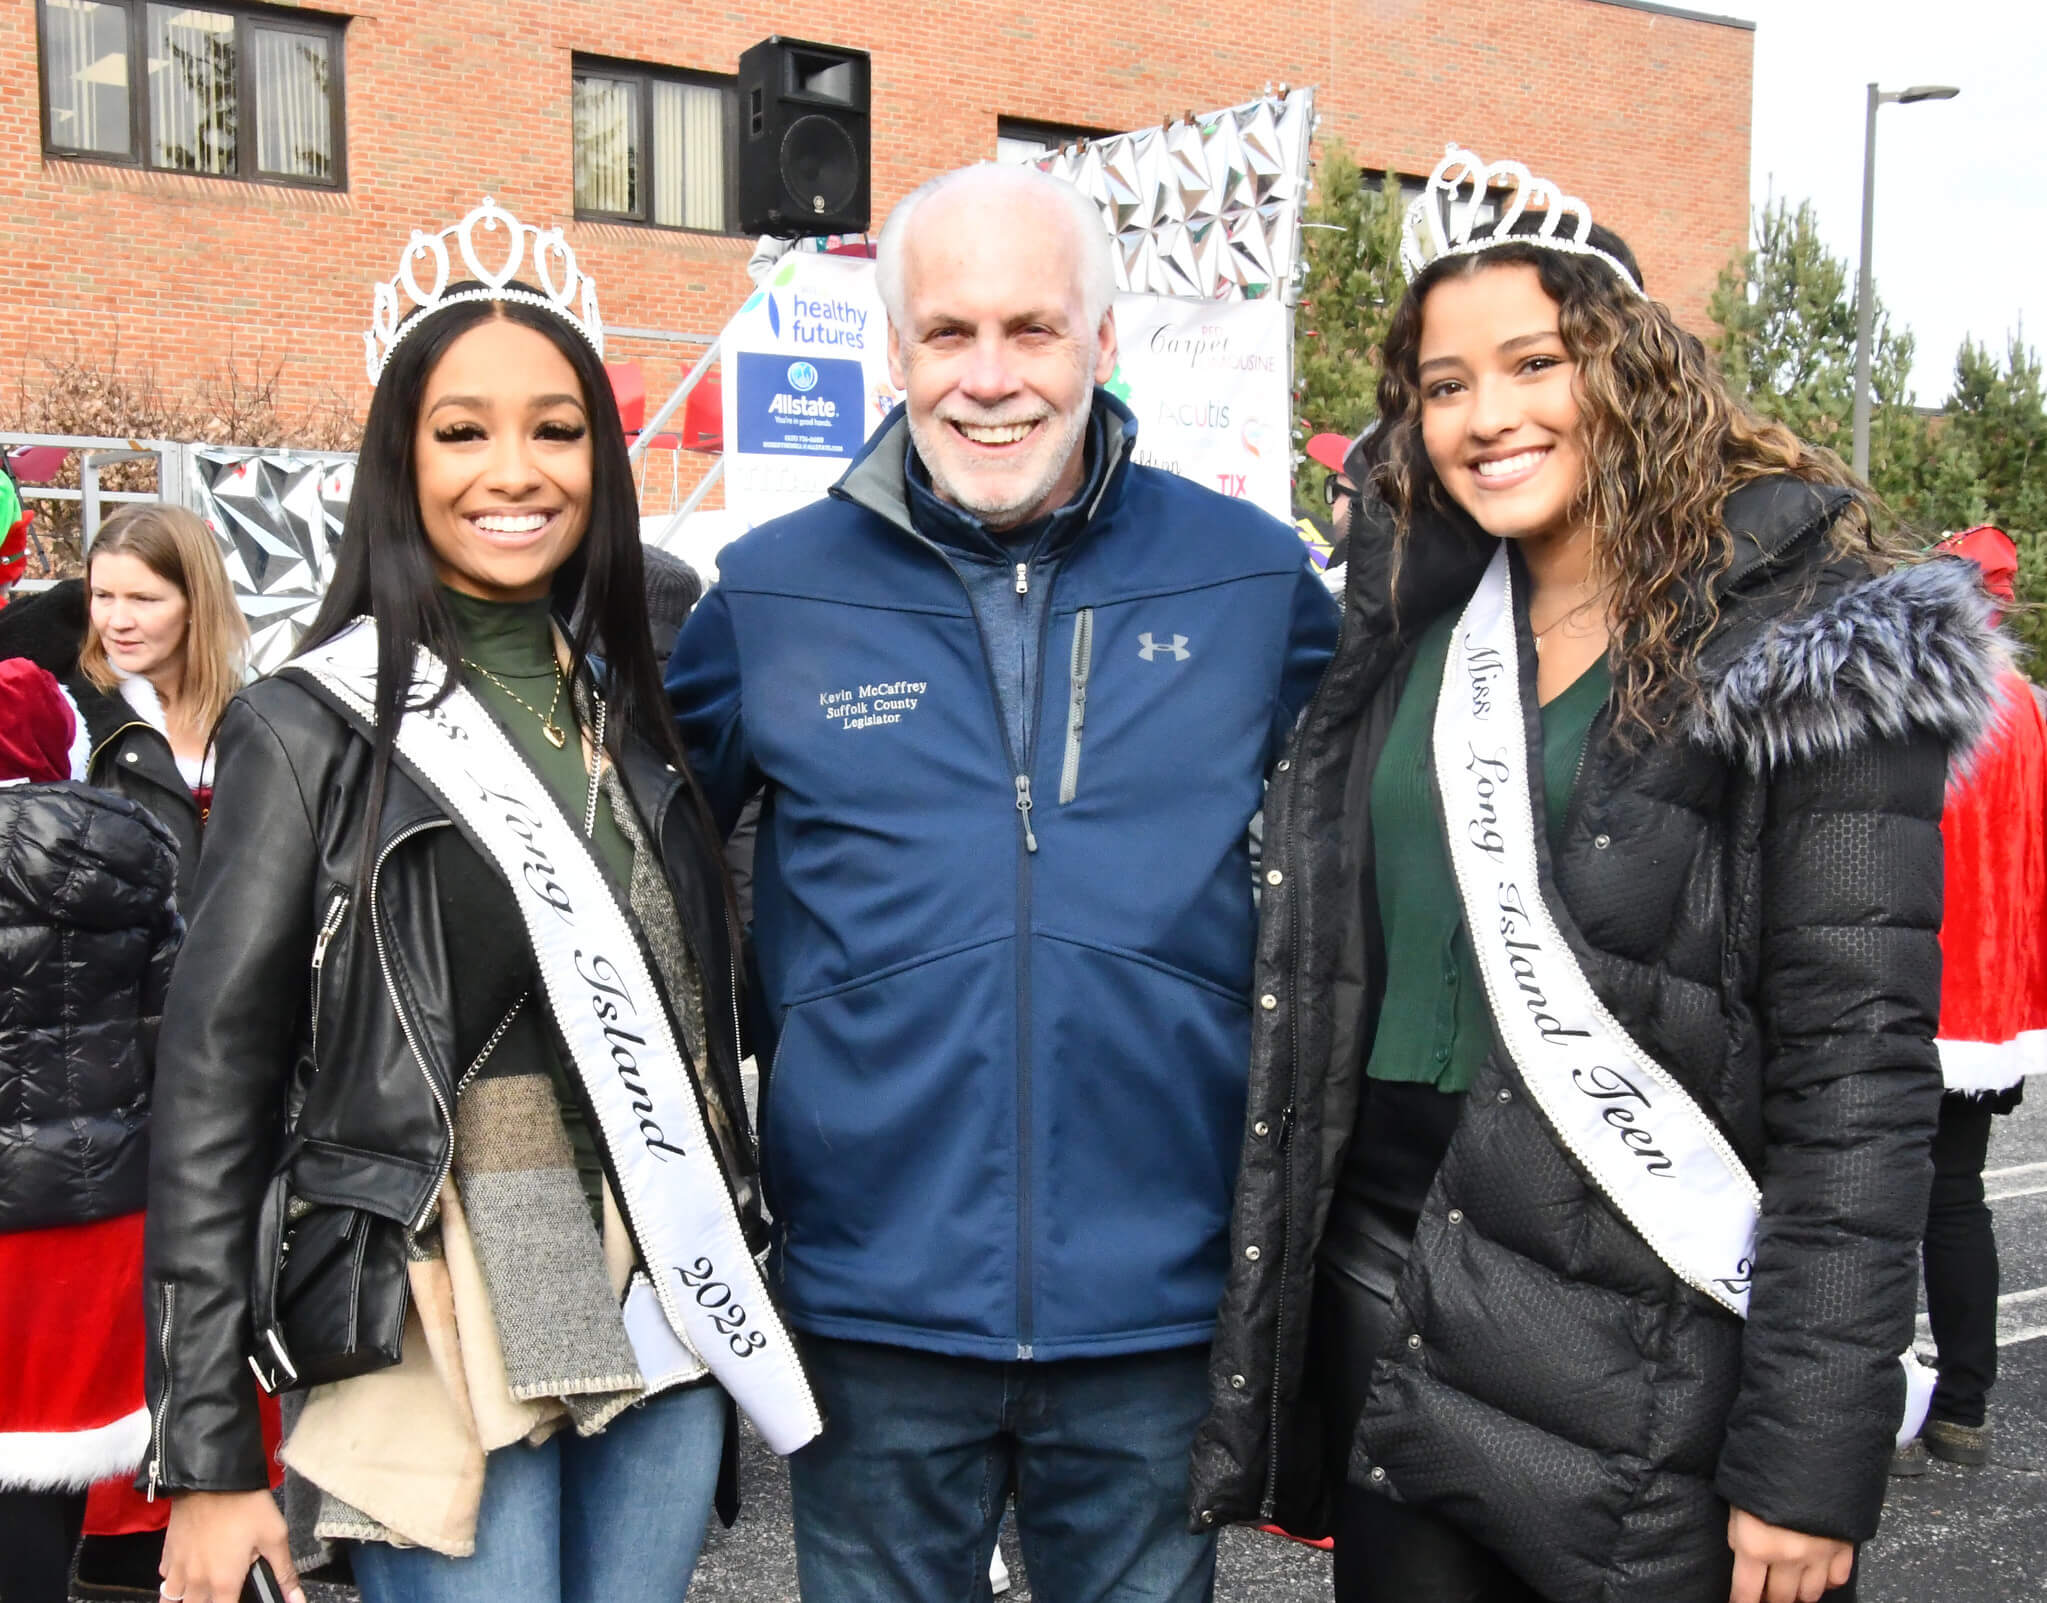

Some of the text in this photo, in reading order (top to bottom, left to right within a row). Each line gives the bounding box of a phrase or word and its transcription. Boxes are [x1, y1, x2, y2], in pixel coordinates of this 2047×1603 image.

[794, 294, 867, 332] healthy
[793, 320, 864, 349] futures
[1150, 323, 1229, 368] Carpet
[1158, 400, 1230, 429] Acutis
[819, 680, 927, 706] Kevin McCaffrey
[826, 698, 918, 719] Suffolk County
[843, 713, 901, 730] Legislator
[1464, 633, 1676, 1179] Miss Long Island Teen
[464, 768, 575, 927] Long
[574, 949, 686, 1163] Island
[672, 1256, 767, 1359] 2023
